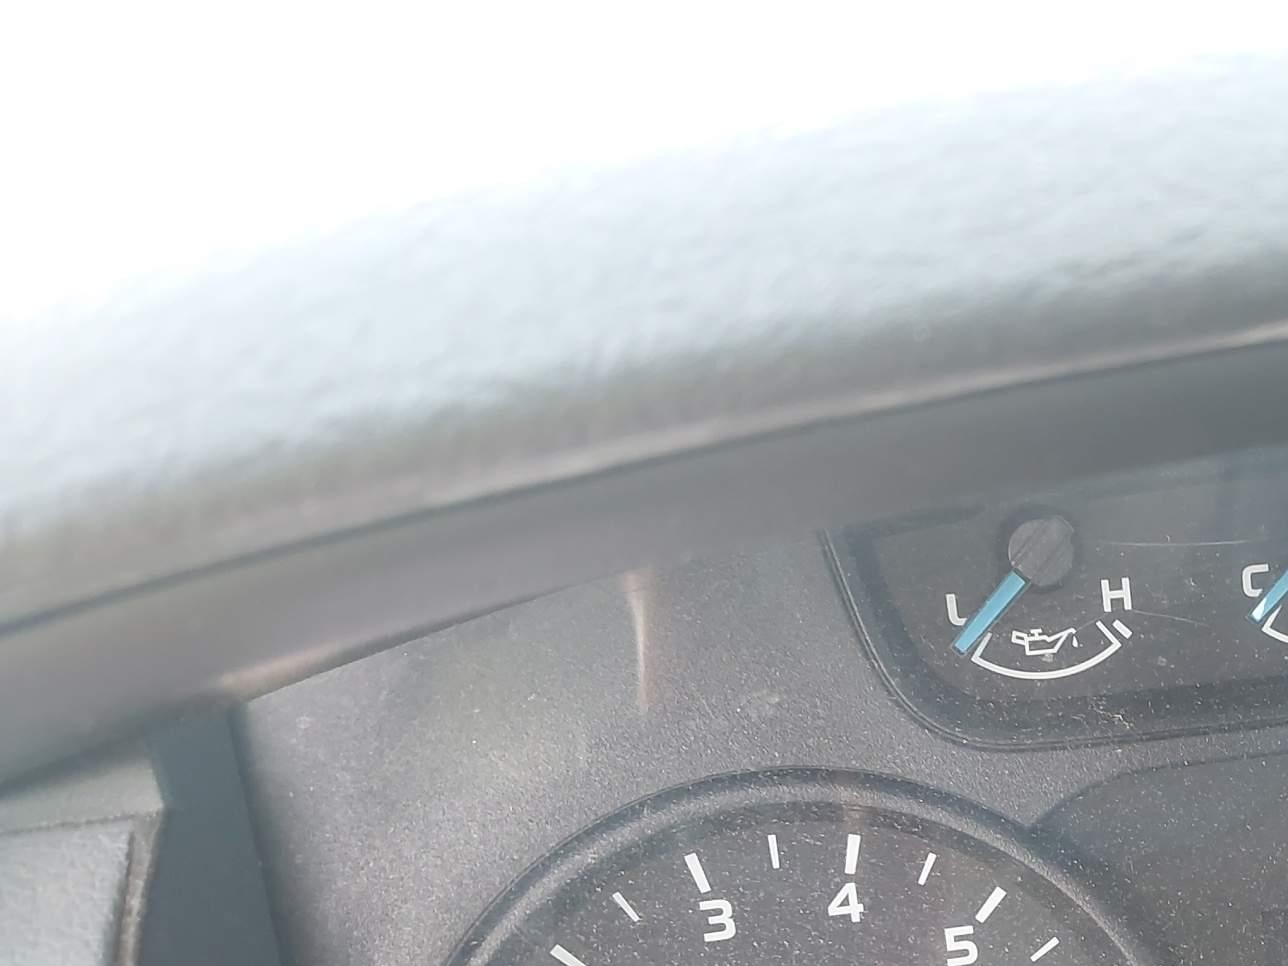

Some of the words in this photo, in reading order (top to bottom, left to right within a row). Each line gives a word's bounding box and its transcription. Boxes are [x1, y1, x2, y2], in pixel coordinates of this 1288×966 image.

[1100, 577, 1133, 613] H
[1242, 563, 1270, 598] C
[698, 899, 738, 942] 3
[826, 882, 865, 923] 4
